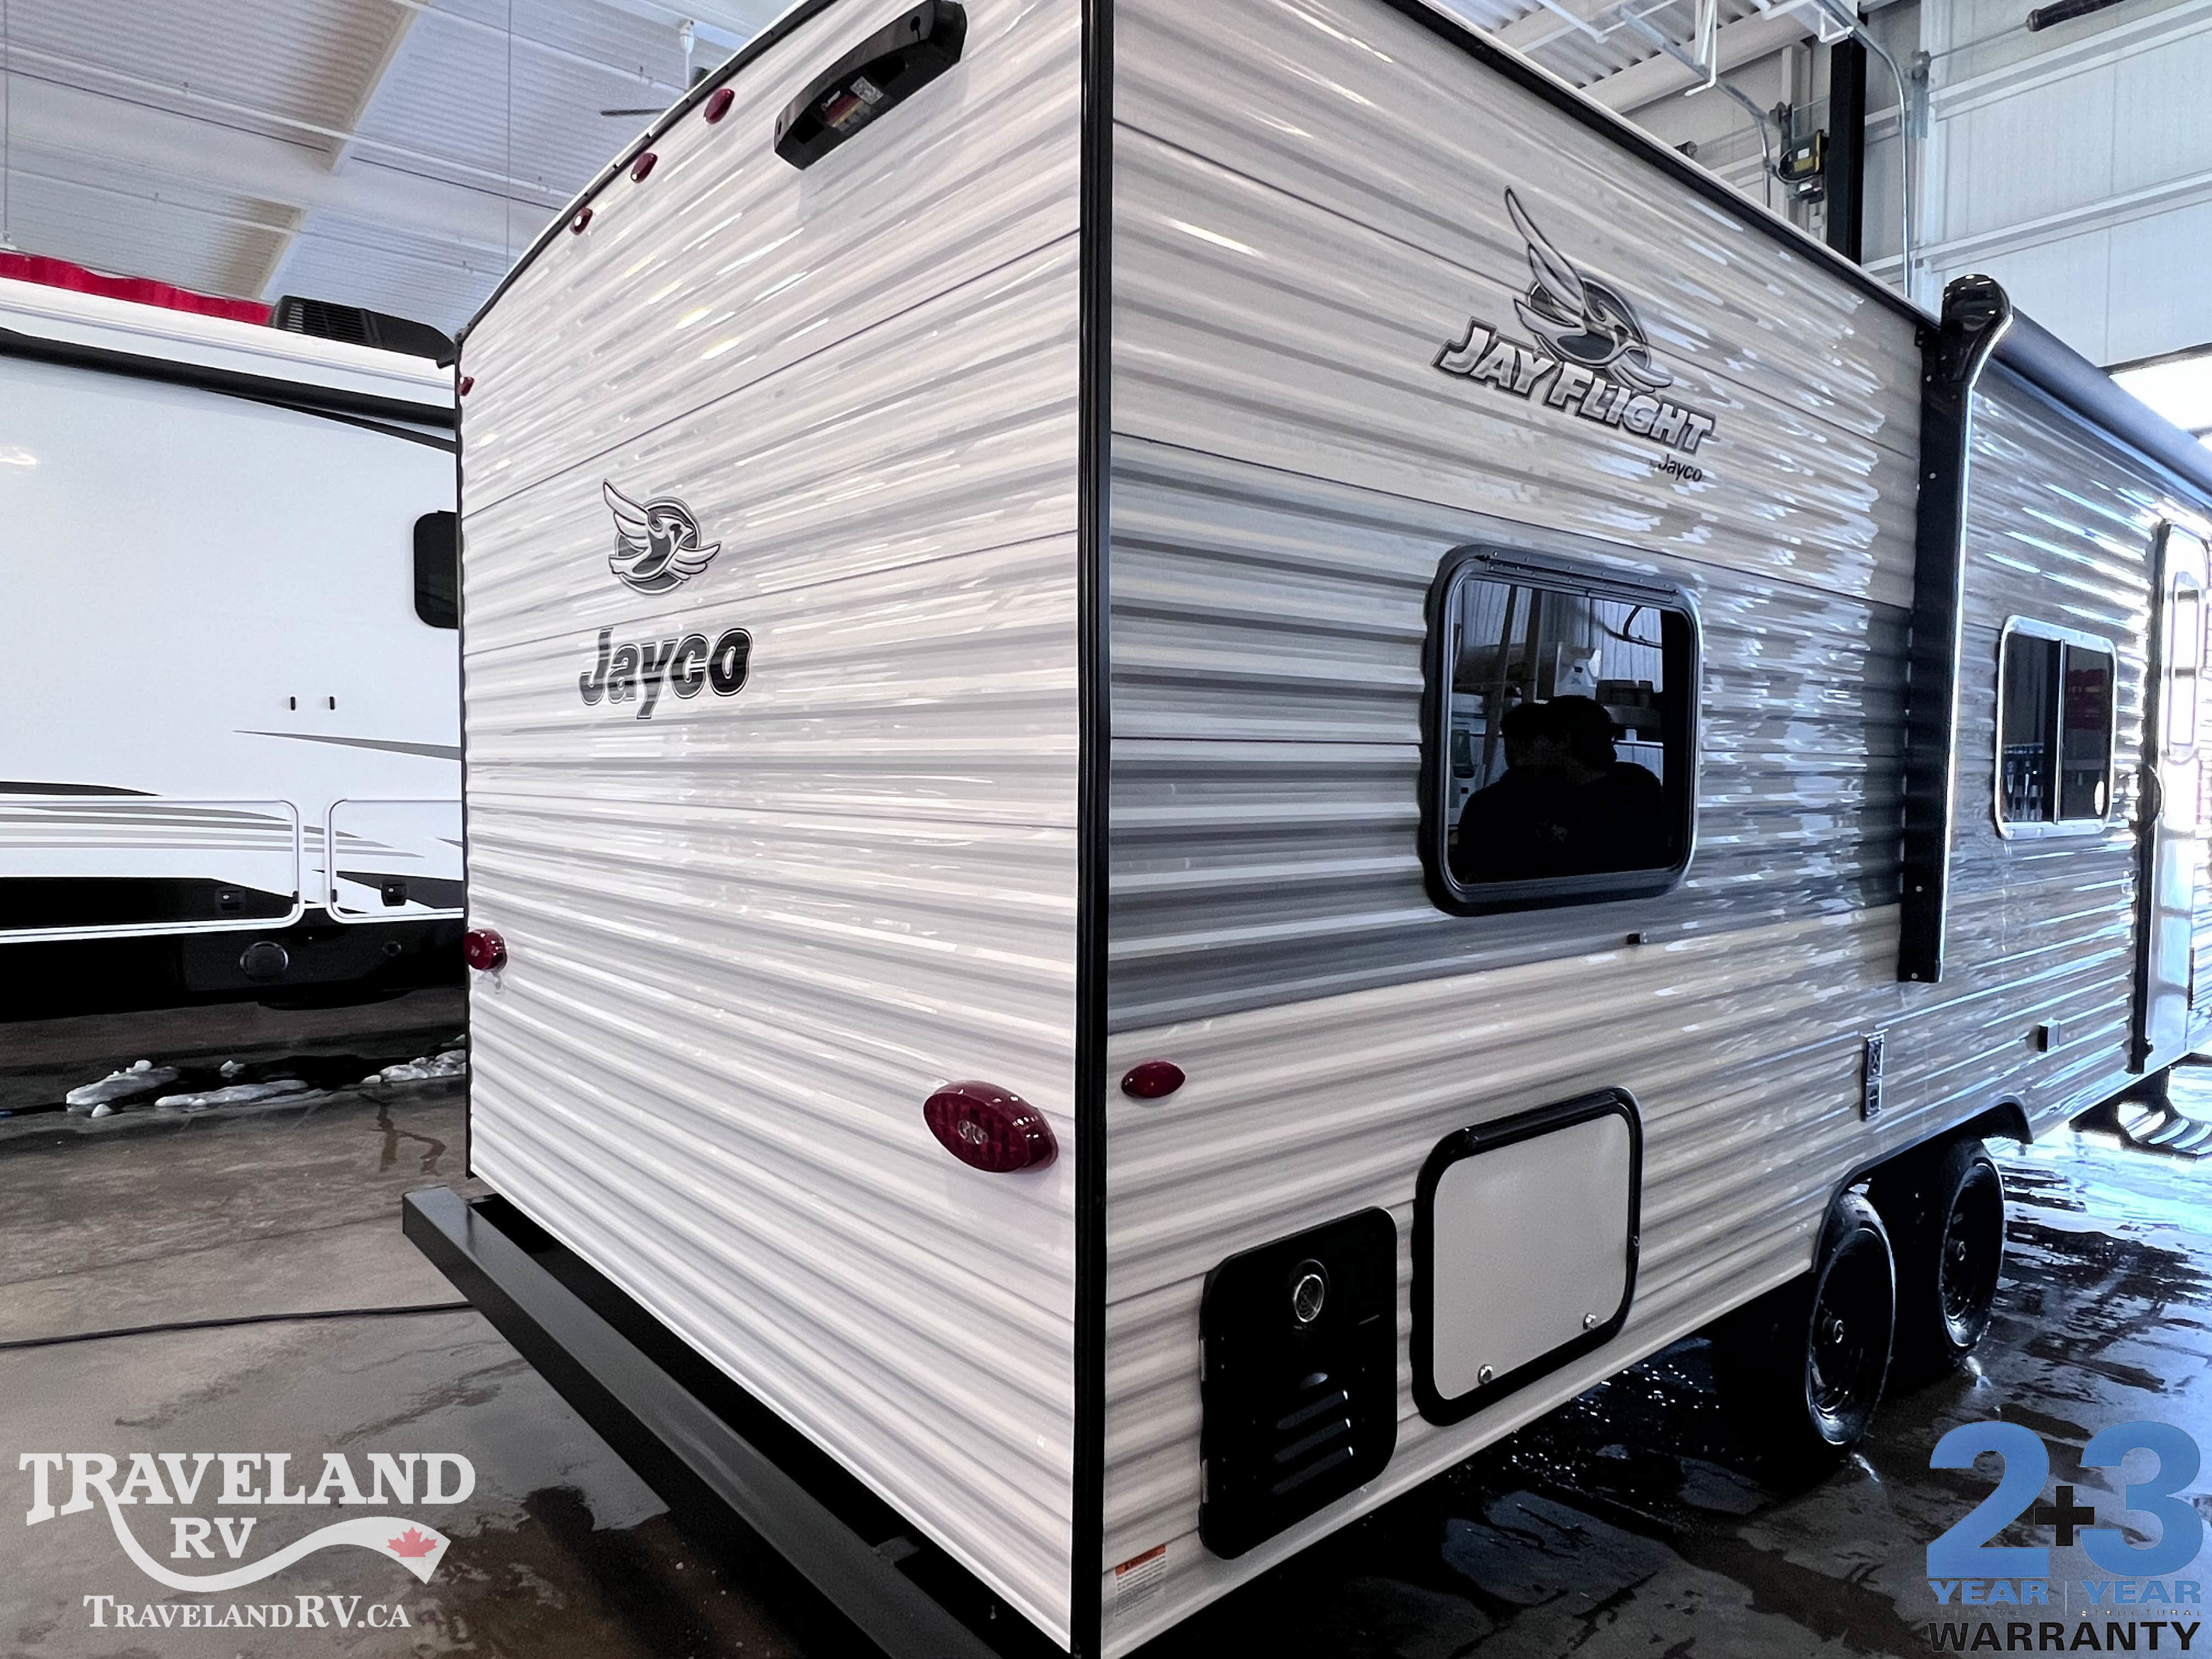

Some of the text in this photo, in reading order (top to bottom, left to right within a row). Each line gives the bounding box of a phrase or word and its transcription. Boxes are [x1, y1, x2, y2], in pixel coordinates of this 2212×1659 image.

[1432, 318, 1716, 455] JAY FLIGHT
[1658, 453, 1703, 482] Jayco
[579, 627, 753, 719] Jayco
